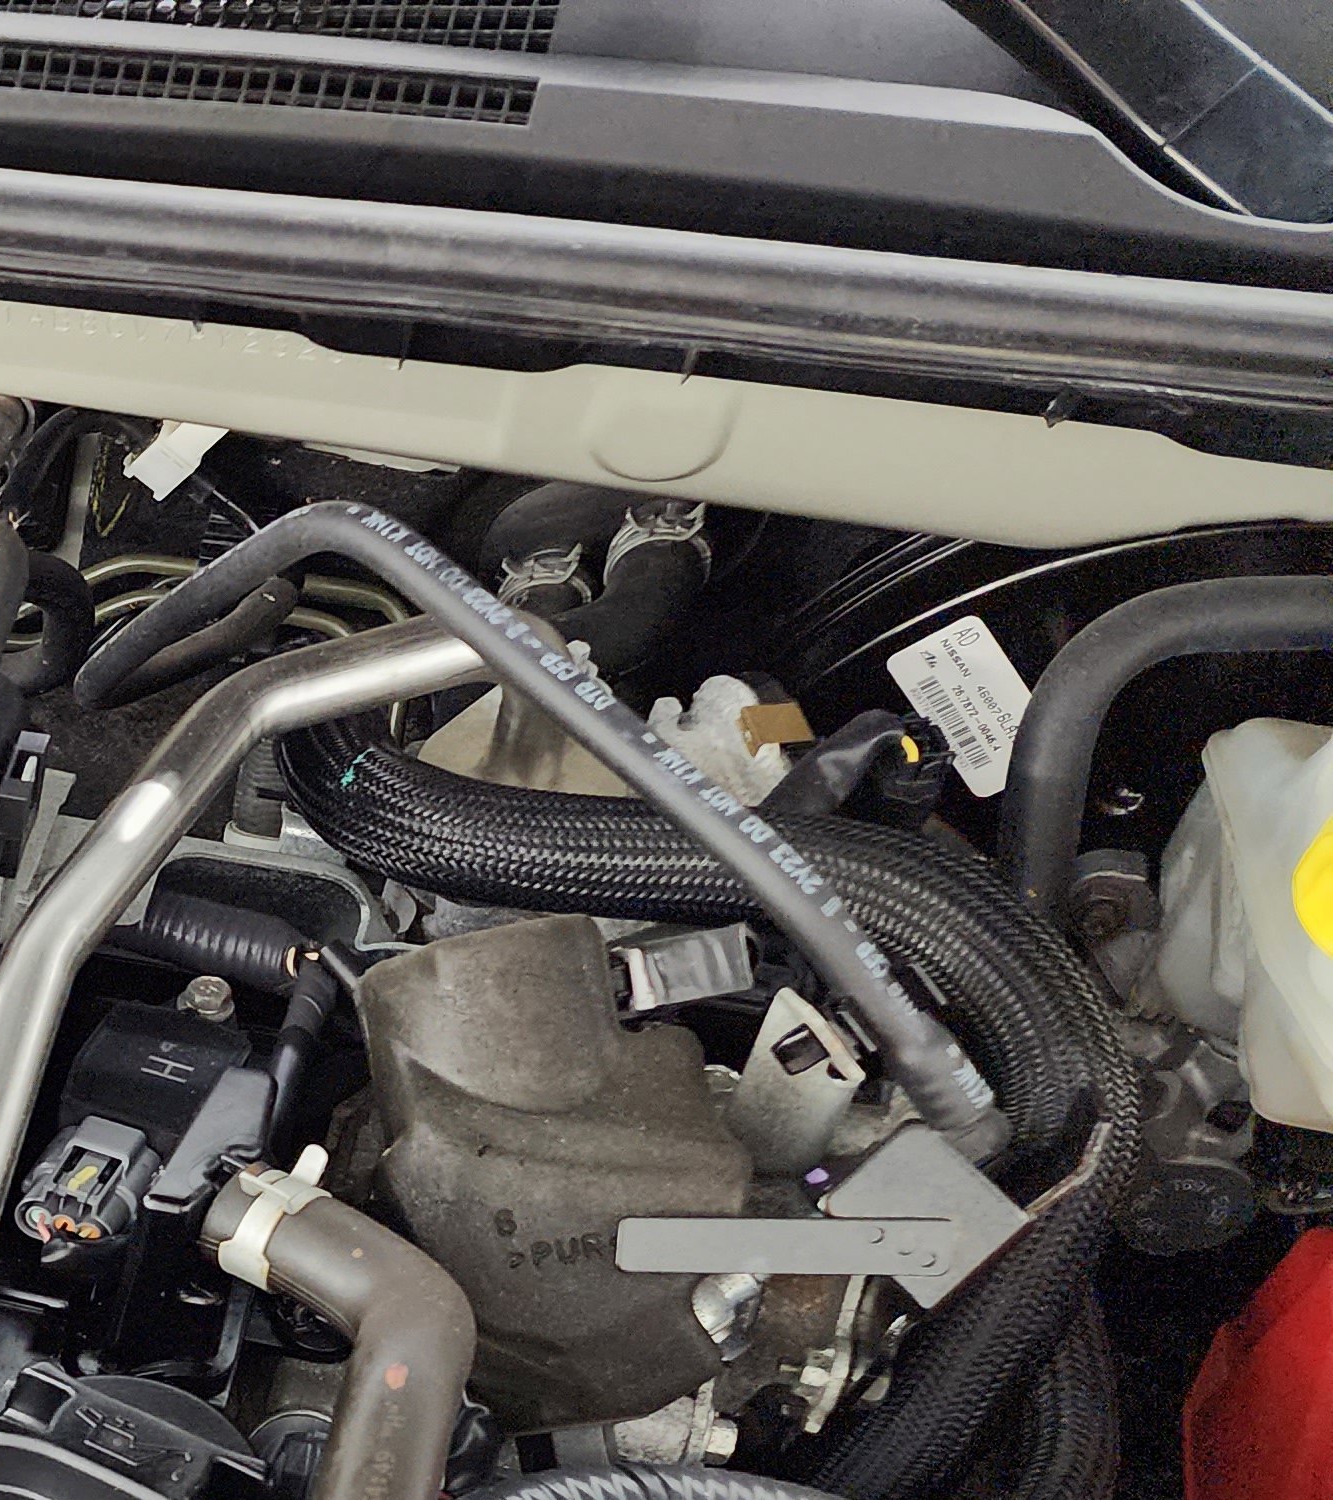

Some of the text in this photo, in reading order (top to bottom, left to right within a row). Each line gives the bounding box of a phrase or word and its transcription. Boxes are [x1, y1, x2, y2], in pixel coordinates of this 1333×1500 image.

[953, 627, 980, 648] AD
[940, 639, 971, 678] NISSAN
[698, 777, 743, 822] NOT
[737, 809, 775, 847] DO
